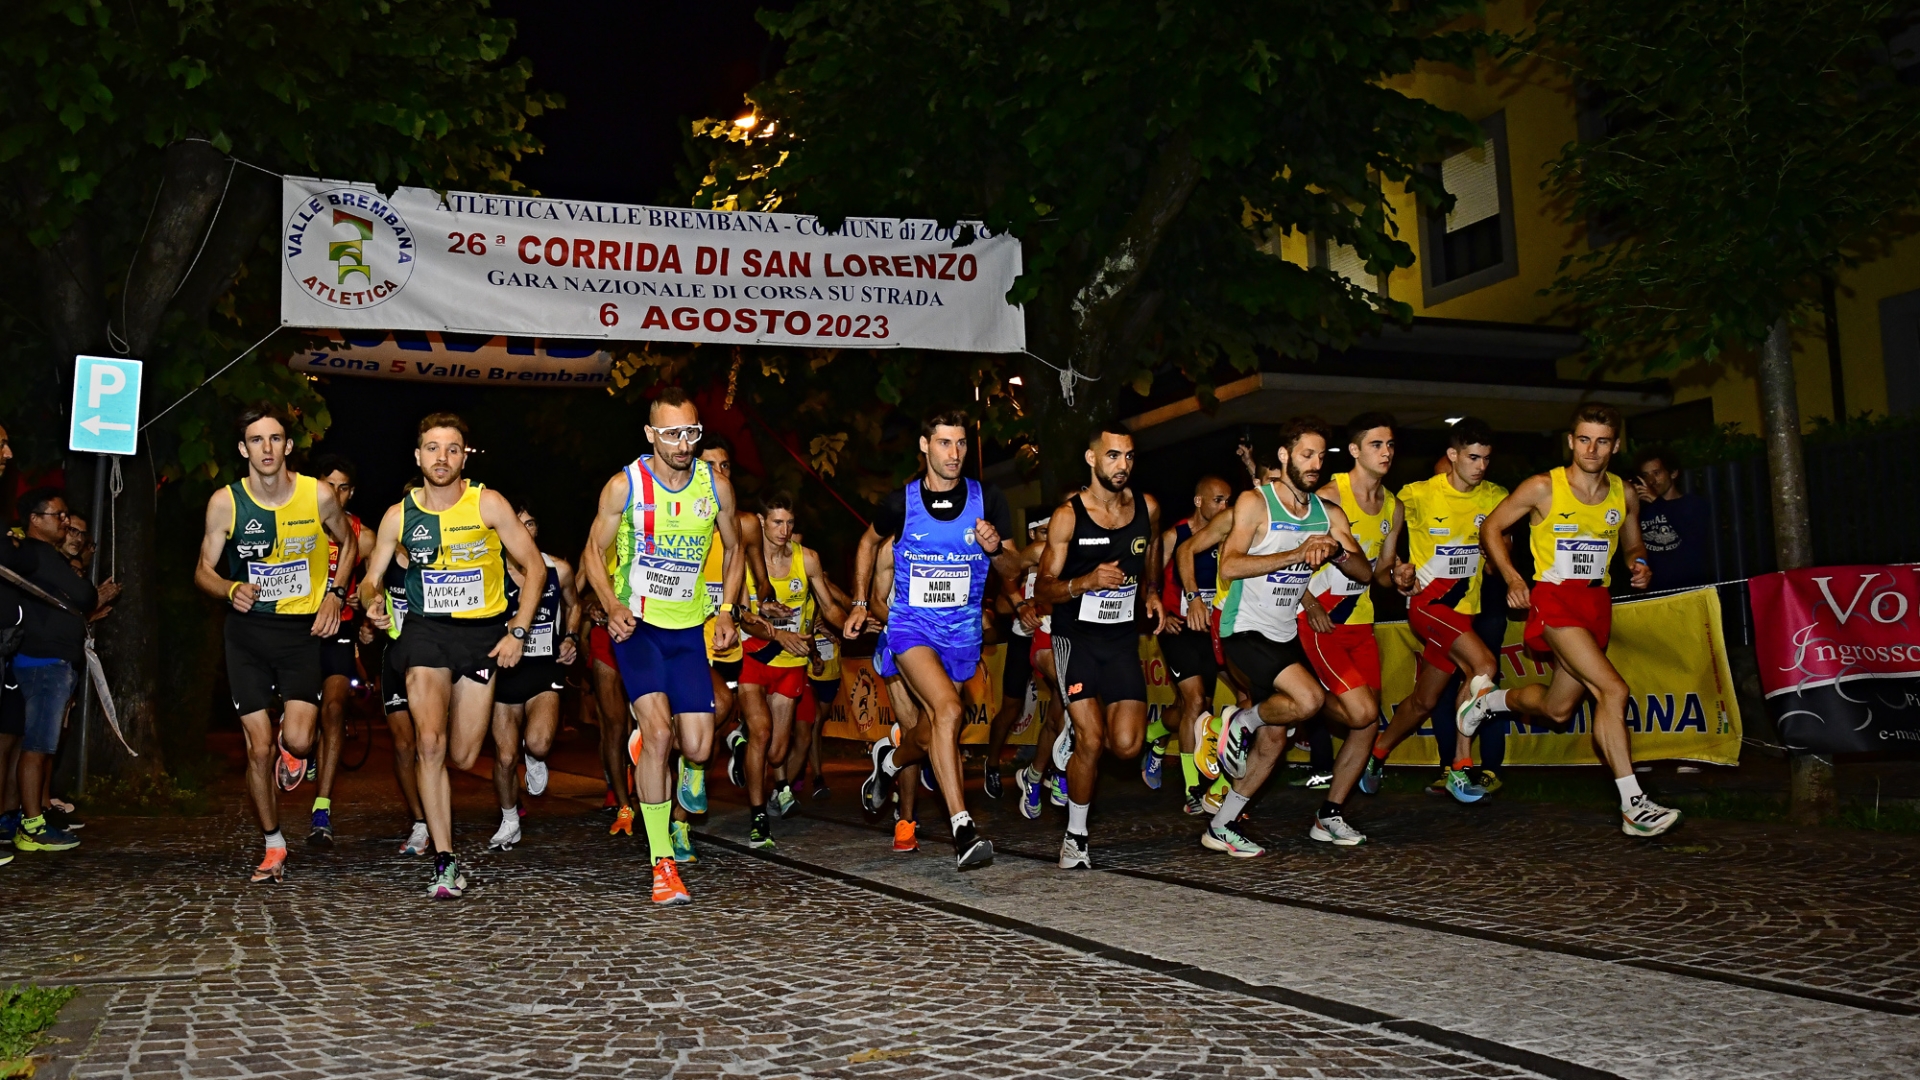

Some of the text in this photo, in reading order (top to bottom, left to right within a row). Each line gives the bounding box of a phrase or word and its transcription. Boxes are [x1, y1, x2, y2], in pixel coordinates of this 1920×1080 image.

[565, 203, 641, 226] VALLE
[649, 210, 779, 234] BREMBANA
[900, 222, 915, 240] di
[288, 192, 413, 265] VALLE BREMBANA
[517, 235, 682, 273] CORRIDA
[695, 246, 729, 276] DI
[741, 248, 811, 278] SAN
[823, 252, 977, 282] LORENZO
[302, 275, 398, 306] ATLETICA
[487, 270, 944, 307] GARA NAZIONALE DI CORSA SU STRADA
[599, 302, 890, 339] 6 AGOSTO 2023
[308, 352, 380, 371] Zona
[389, 359, 406, 374] 5
[415, 362, 481, 379] Valle
[88, 364, 126, 408] P
[903, 550, 945, 562] Fiamme
[1449, 556, 1468, 566] DANILO
[1572, 553, 1594, 564] NICOLA
[1449, 566, 1466, 575] GRITTI
[1573, 564, 1592, 575] BONZI
[255, 573, 297, 588] ANDREA
[646, 571, 680, 586] VINCENZO
[289, 583, 303, 594] 29
[427, 585, 466, 597] ANDREA
[649, 584, 693, 598] SCURO 25
[929, 581, 951, 591] NADIR
[923, 592, 968, 603] CAVAGNA 2
[1275, 598, 1292, 607] LOLLO
[1811, 568, 1920, 625] Vo
[428, 599, 460, 609] LAURIA
[1099, 600, 1122, 610] AHMED
[1127, 610, 1132, 618] 3
[543, 645, 551, 653] 19
